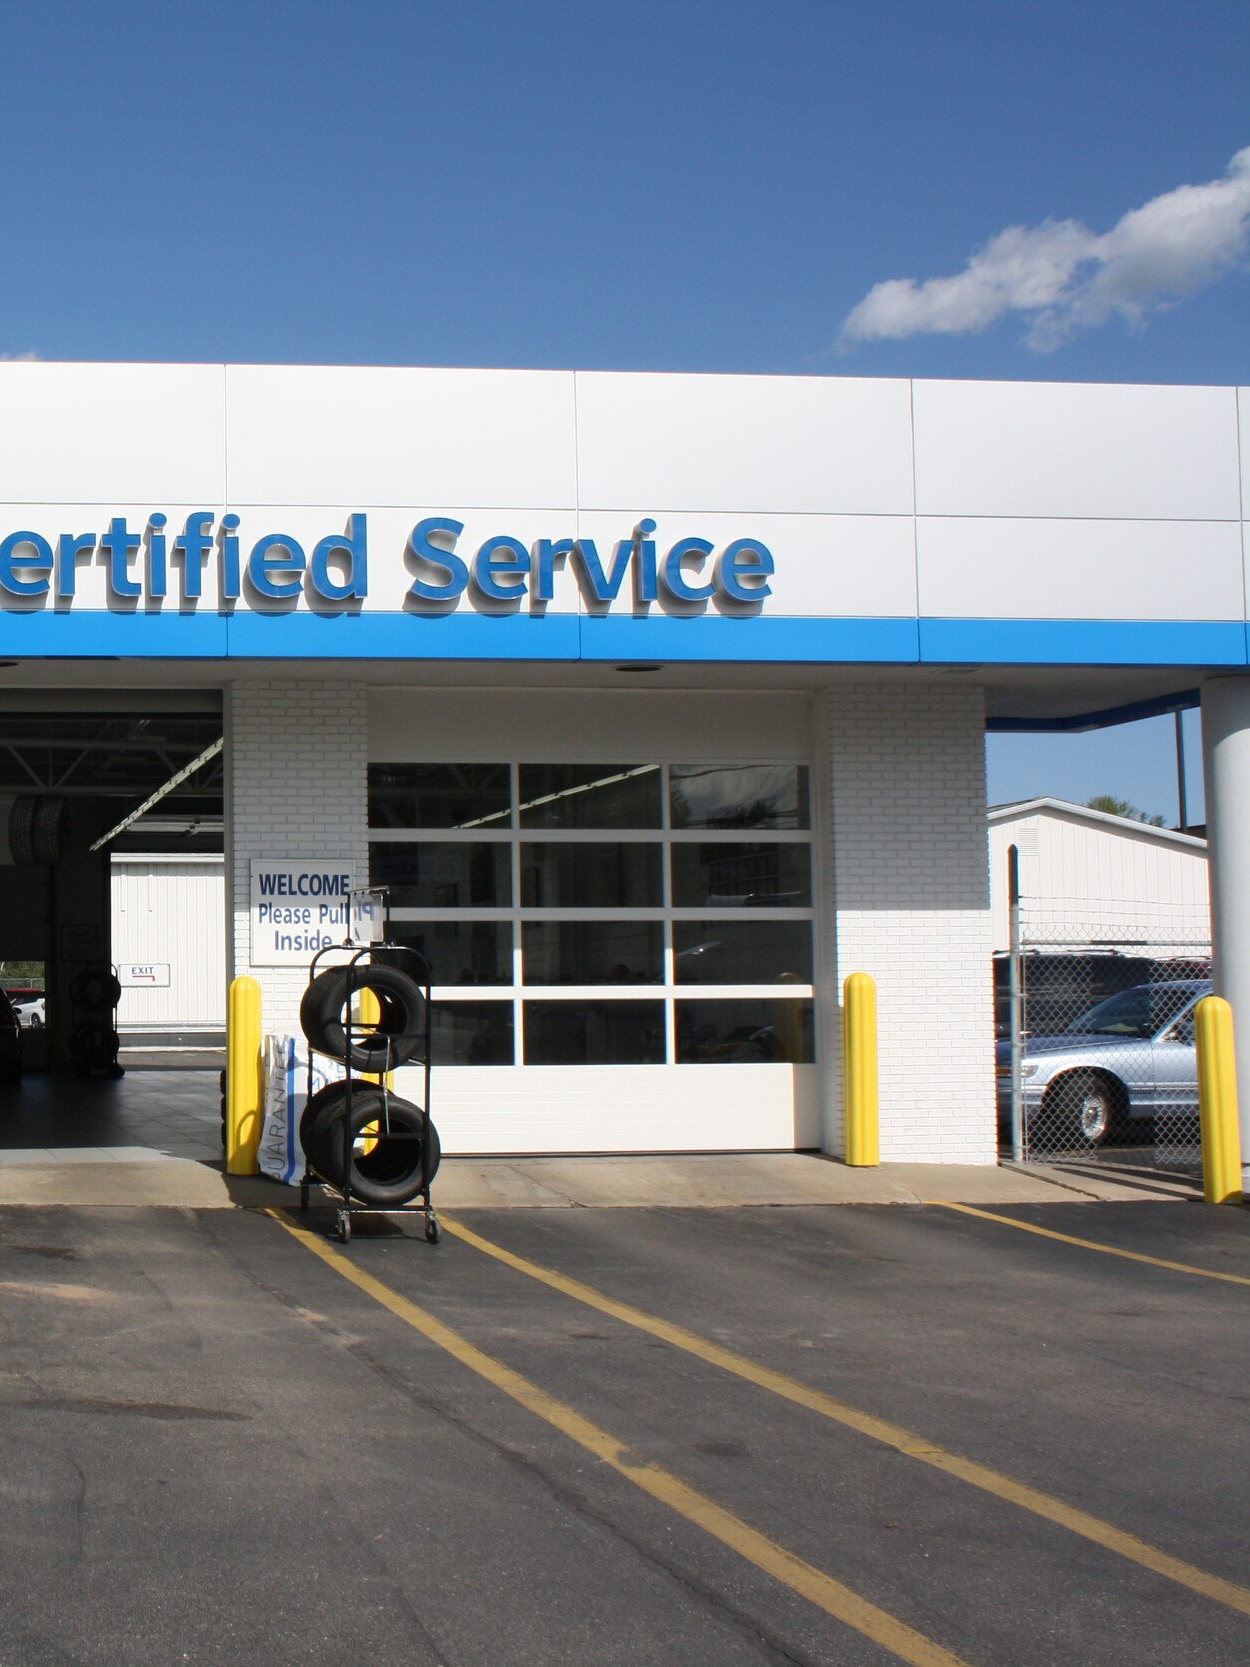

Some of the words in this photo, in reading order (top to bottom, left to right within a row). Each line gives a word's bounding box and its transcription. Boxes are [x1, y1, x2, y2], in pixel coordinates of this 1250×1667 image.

[404, 517, 775, 602] Service
[259, 874, 350, 896] WELCOME
[258, 902, 311, 924] Please
[319, 903, 349, 924] Pull
[274, 929, 333, 951] Inside
[131, 966, 154, 975] EXIT
